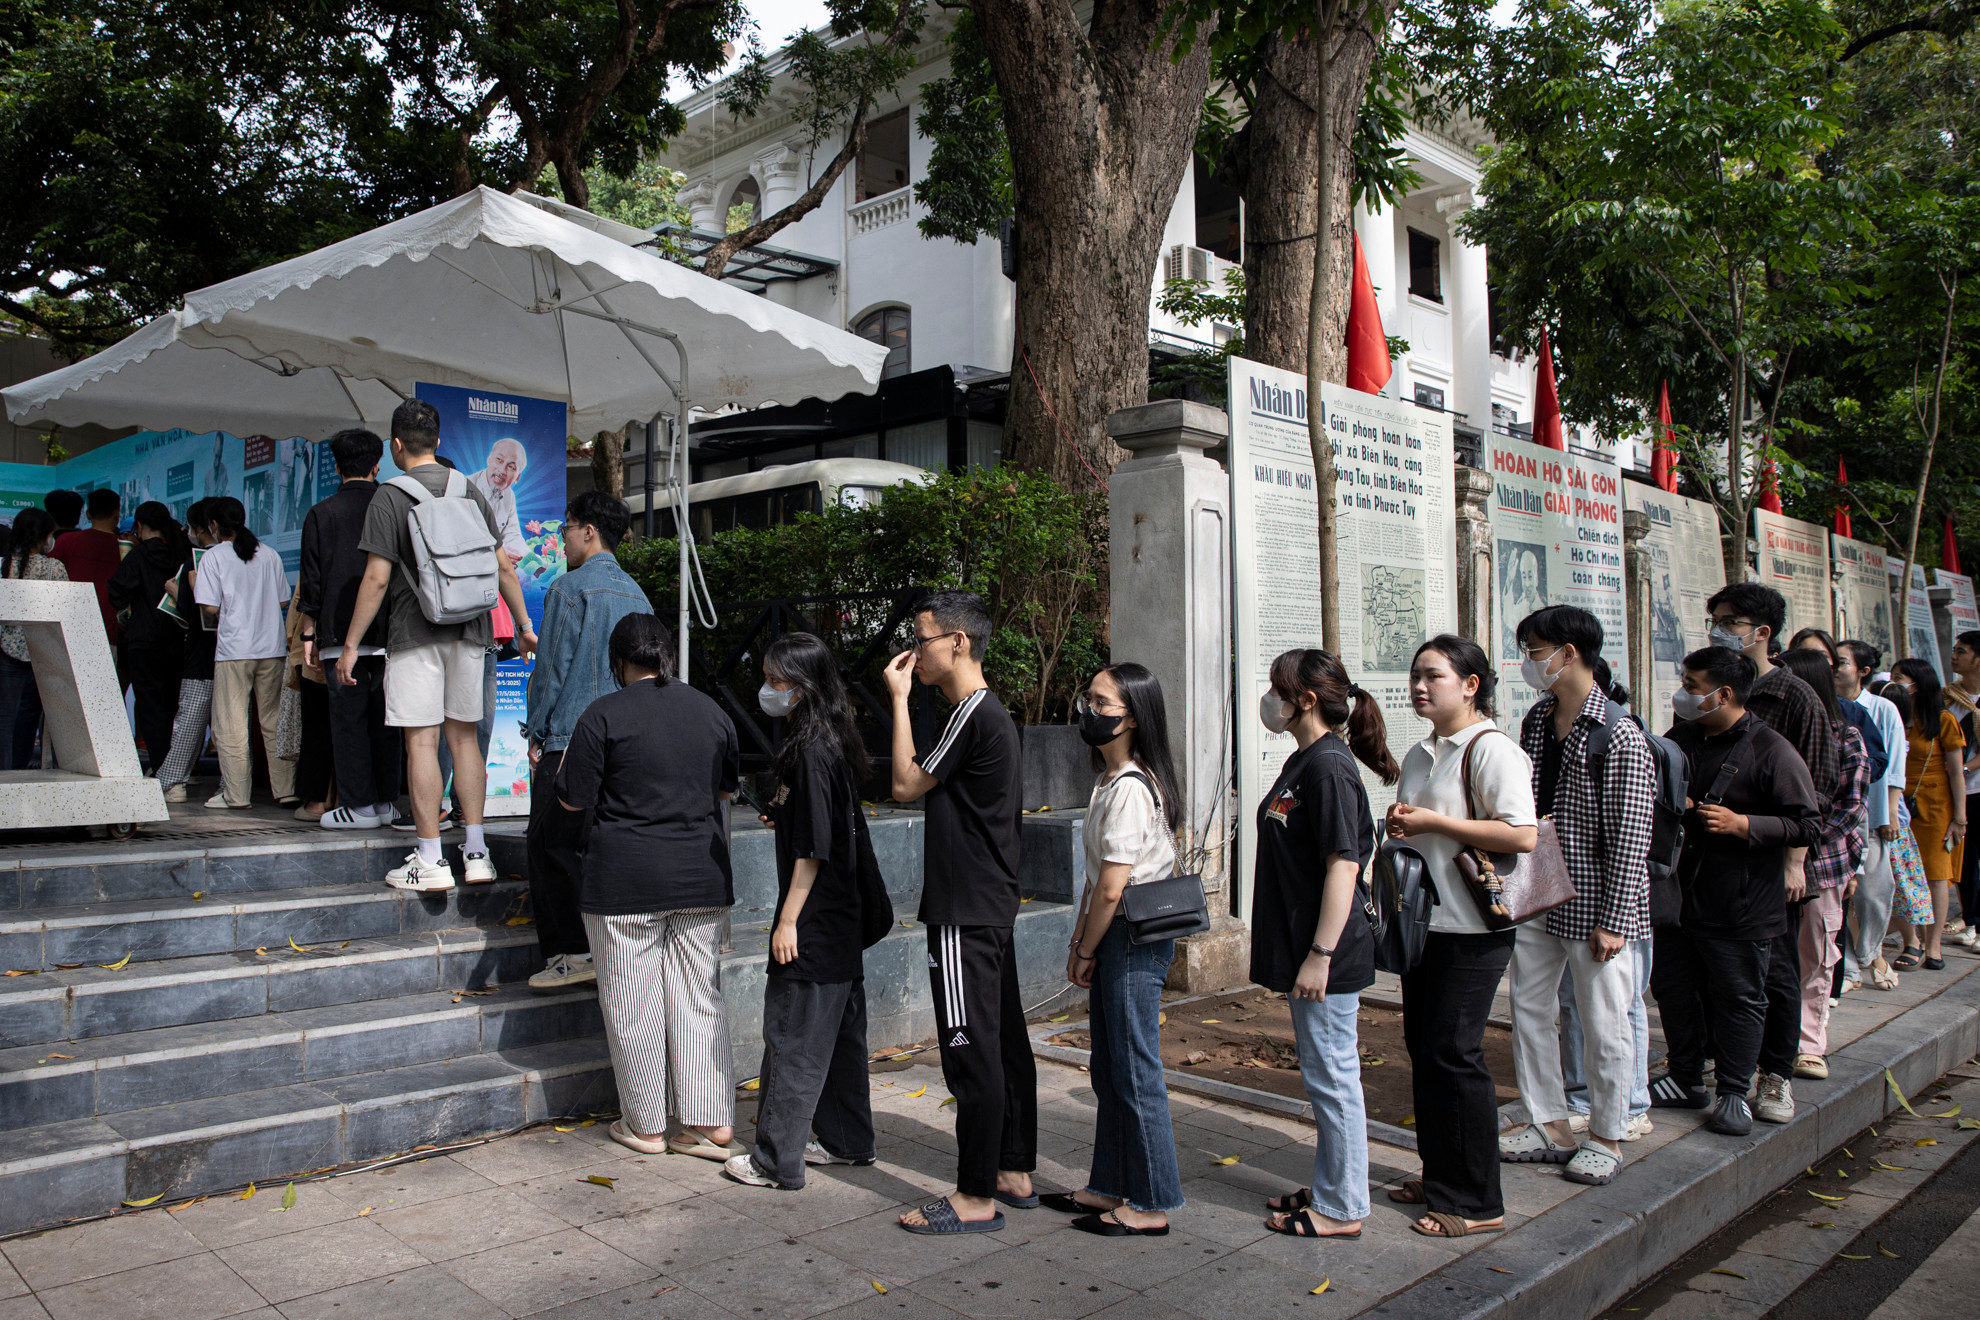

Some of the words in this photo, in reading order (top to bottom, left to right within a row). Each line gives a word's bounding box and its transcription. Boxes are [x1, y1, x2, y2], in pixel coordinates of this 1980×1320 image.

[468, 397, 497, 413] Nhân
[497, 400, 519, 416] Dân
[1249, 376, 1293, 418] Nhân
[1330, 413, 1347, 433] Giải
[1352, 420, 1377, 442] phóng
[1382, 426, 1401, 446] hoàn
[1405, 432, 1422, 451] toàn
[1361, 444, 1379, 464] Biên
[1276, 468, 1293, 488] HIỆU
[1493, 449, 1538, 480] HOAN
[1542, 461, 1562, 485] HÔ
[1567, 465, 1587, 490] SÀI
[1591, 471, 1617, 497] GÒN
[1390, 474, 1407, 493] Biên
[1408, 478, 1423, 496] Hòa
[1342, 492, 1353, 507] và
[1374, 495, 1400, 514] Phước
[1402, 500, 1416, 520] Tuy
[1496, 483, 1523, 510] Nhân
[1524, 488, 1543, 514] Dân
[1543, 489, 1571, 516] GIẢI
[1575, 497, 1617, 524] PHÓNG
[1577, 526, 1601, 543] Chiến
[1602, 531, 1619, 547] dịch
[1571, 547, 1584, 563] Hồ
[1586, 550, 1600, 564] Chí
[1601, 551, 1620, 567] Minh
[1572, 570, 1593, 585] toàn
[1598, 572, 1621, 592] thắng
[496, 670, 504, 678] HỦ
